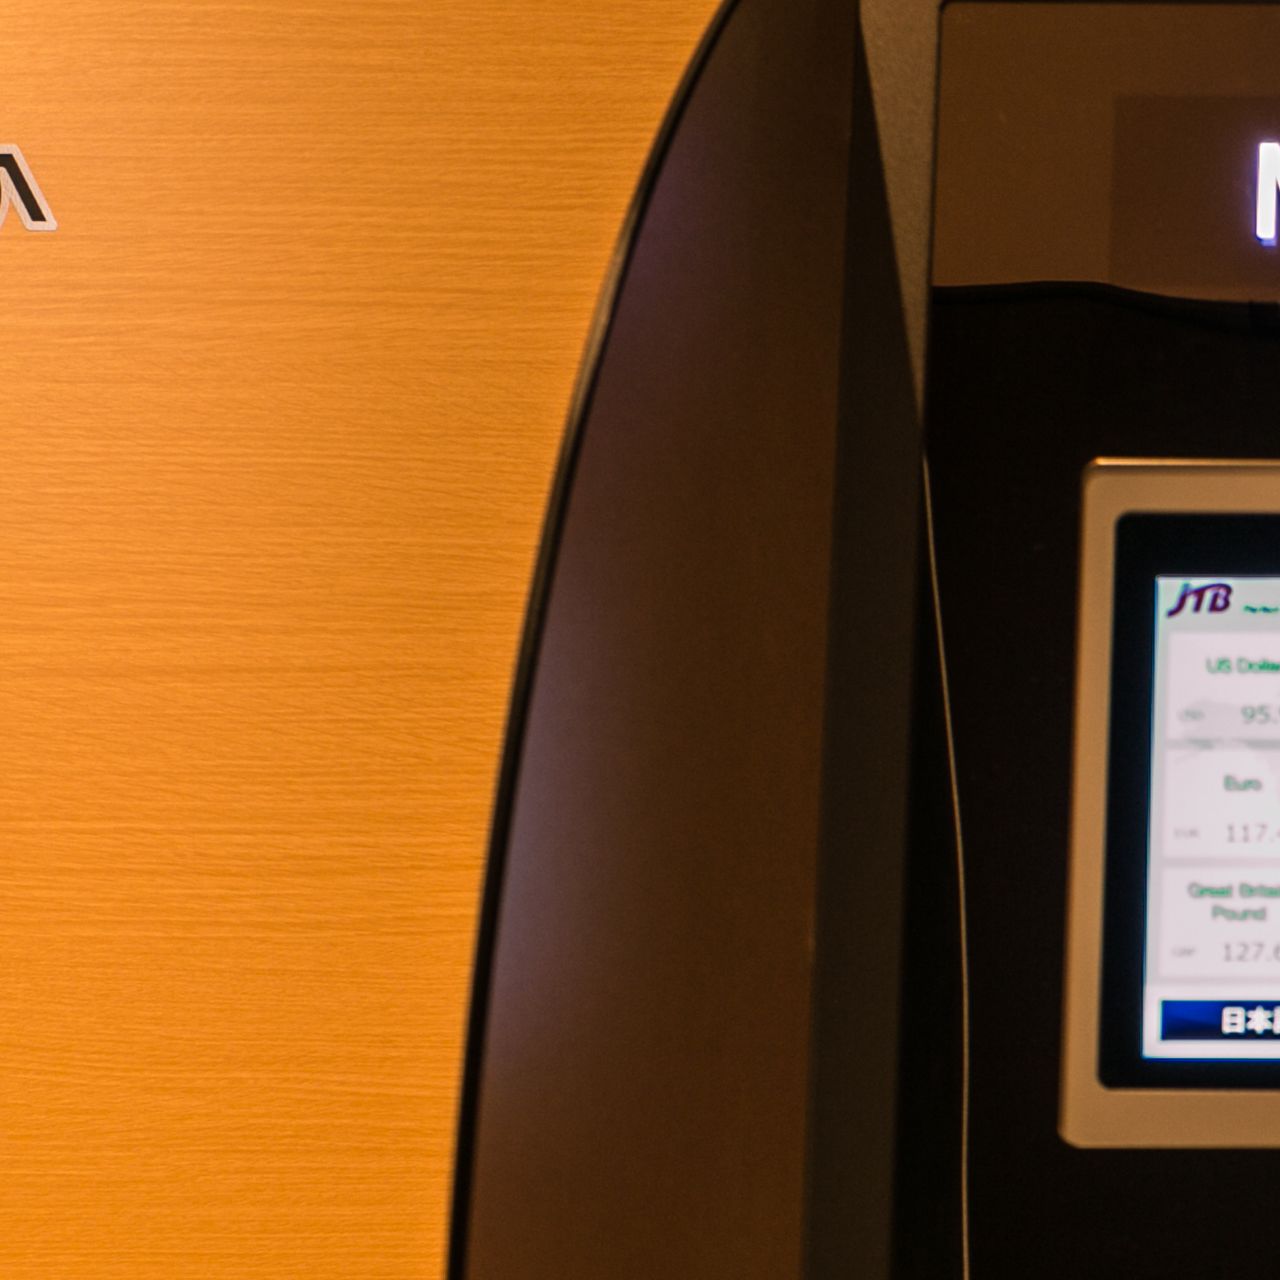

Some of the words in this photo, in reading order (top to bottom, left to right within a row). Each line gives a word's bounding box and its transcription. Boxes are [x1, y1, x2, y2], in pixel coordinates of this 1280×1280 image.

[1167, 583, 1234, 617] JTB
[1206, 658, 1232, 674] US
[1224, 776, 1263, 793] Euro
